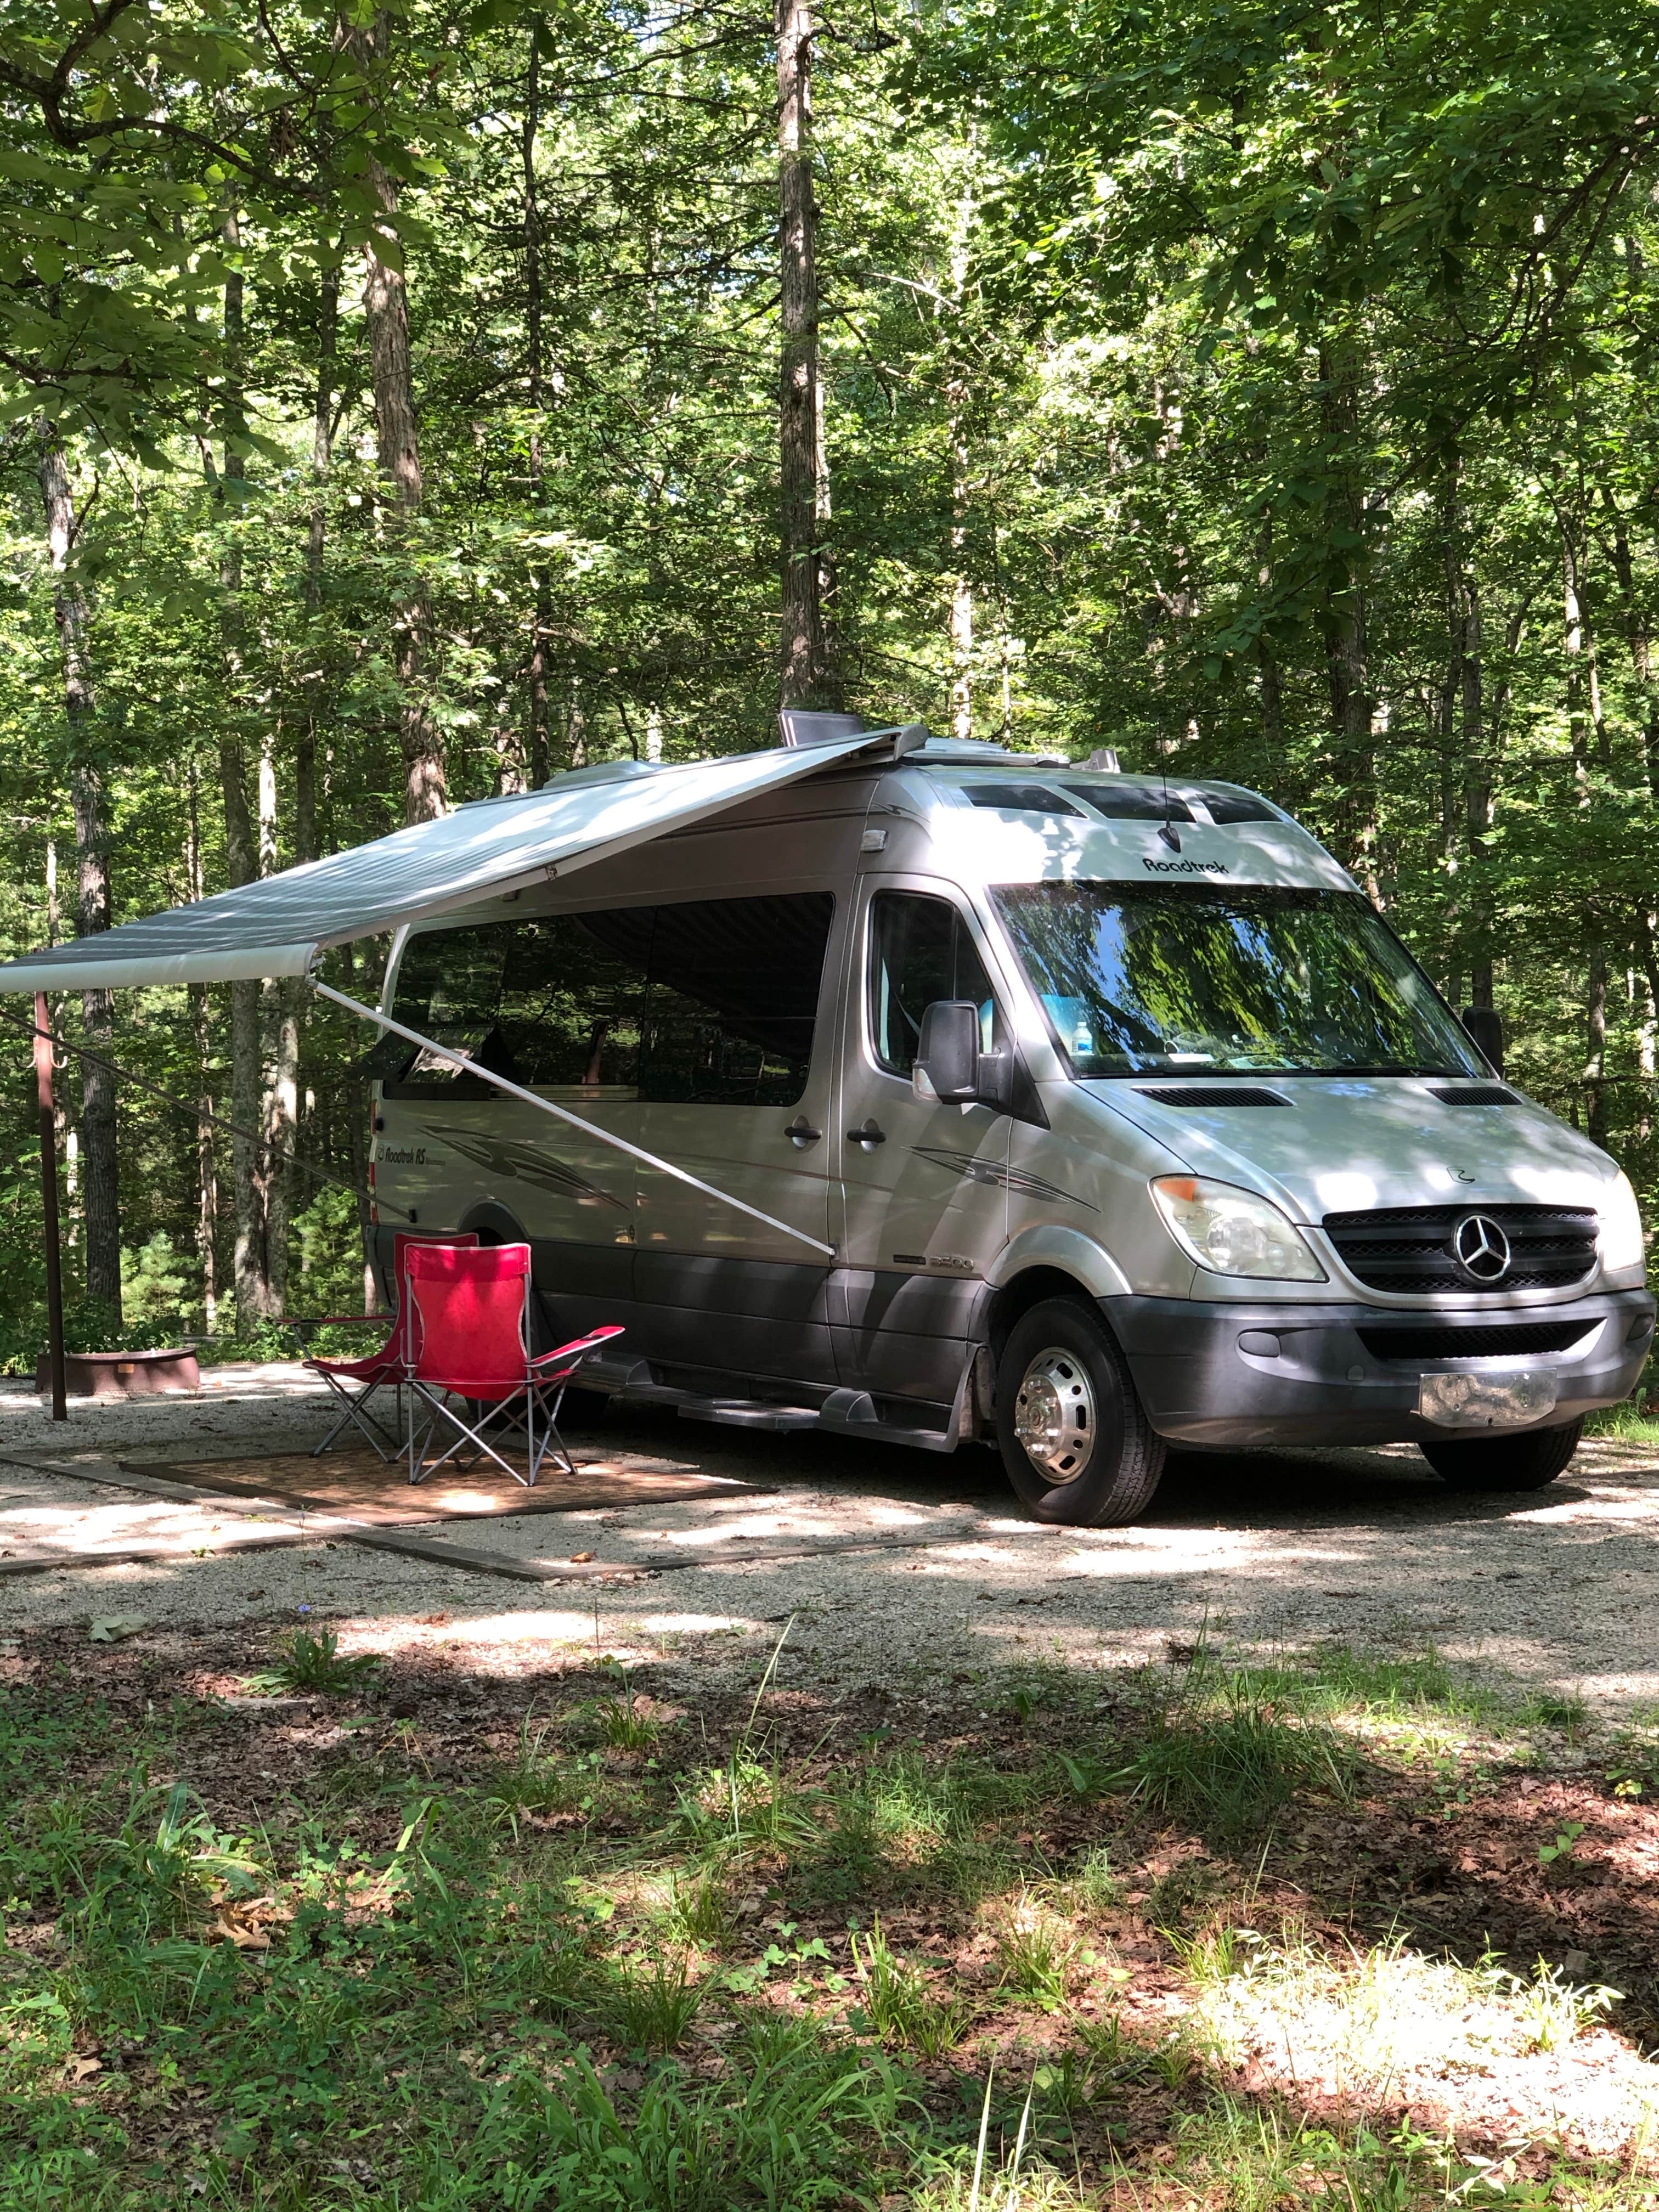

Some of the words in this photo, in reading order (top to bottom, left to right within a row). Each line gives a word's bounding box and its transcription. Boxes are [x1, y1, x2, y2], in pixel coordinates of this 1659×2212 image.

[1142, 858, 1229, 874] Roadtrek
[385, 1147, 414, 1165] Roadtrek
[415, 1148, 426, 1165] RS
